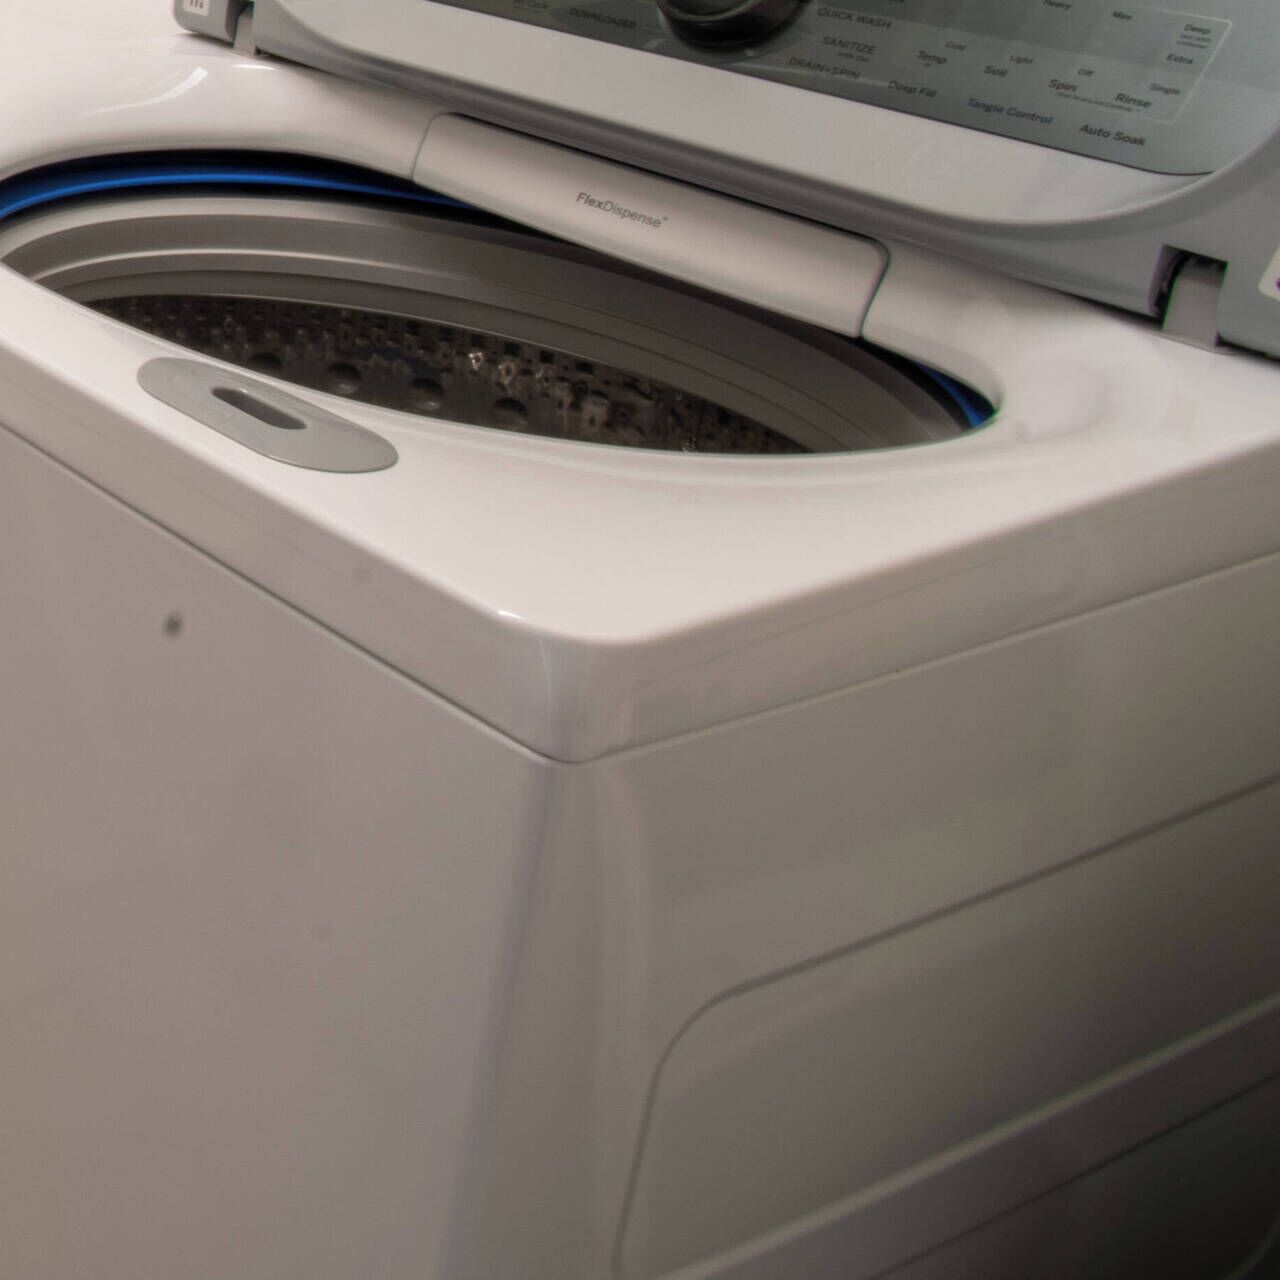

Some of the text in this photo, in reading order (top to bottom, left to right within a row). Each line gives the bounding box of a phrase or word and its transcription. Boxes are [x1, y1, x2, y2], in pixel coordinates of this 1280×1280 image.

[568, 7, 637, 29] DOWNLOADED
[817, 7, 893, 29] QUICK WASH
[1184, 23, 1212, 35] Deep
[823, 35, 877, 55] SANITIZE
[917, 50, 948, 65] Temp
[1165, 53, 1195, 65] Extra
[983, 64, 1008, 77] Soil
[888, 80, 937, 98] Deep Fill
[1048, 78, 1078, 93] Spin
[1149, 82, 1182, 96] Single
[1114, 92, 1152, 109] Rinse
[968, 97, 1053, 124] Tangle Control
[1079, 124, 1146, 147] Auto Soak
[576, 192, 663, 228] FlexDispense
